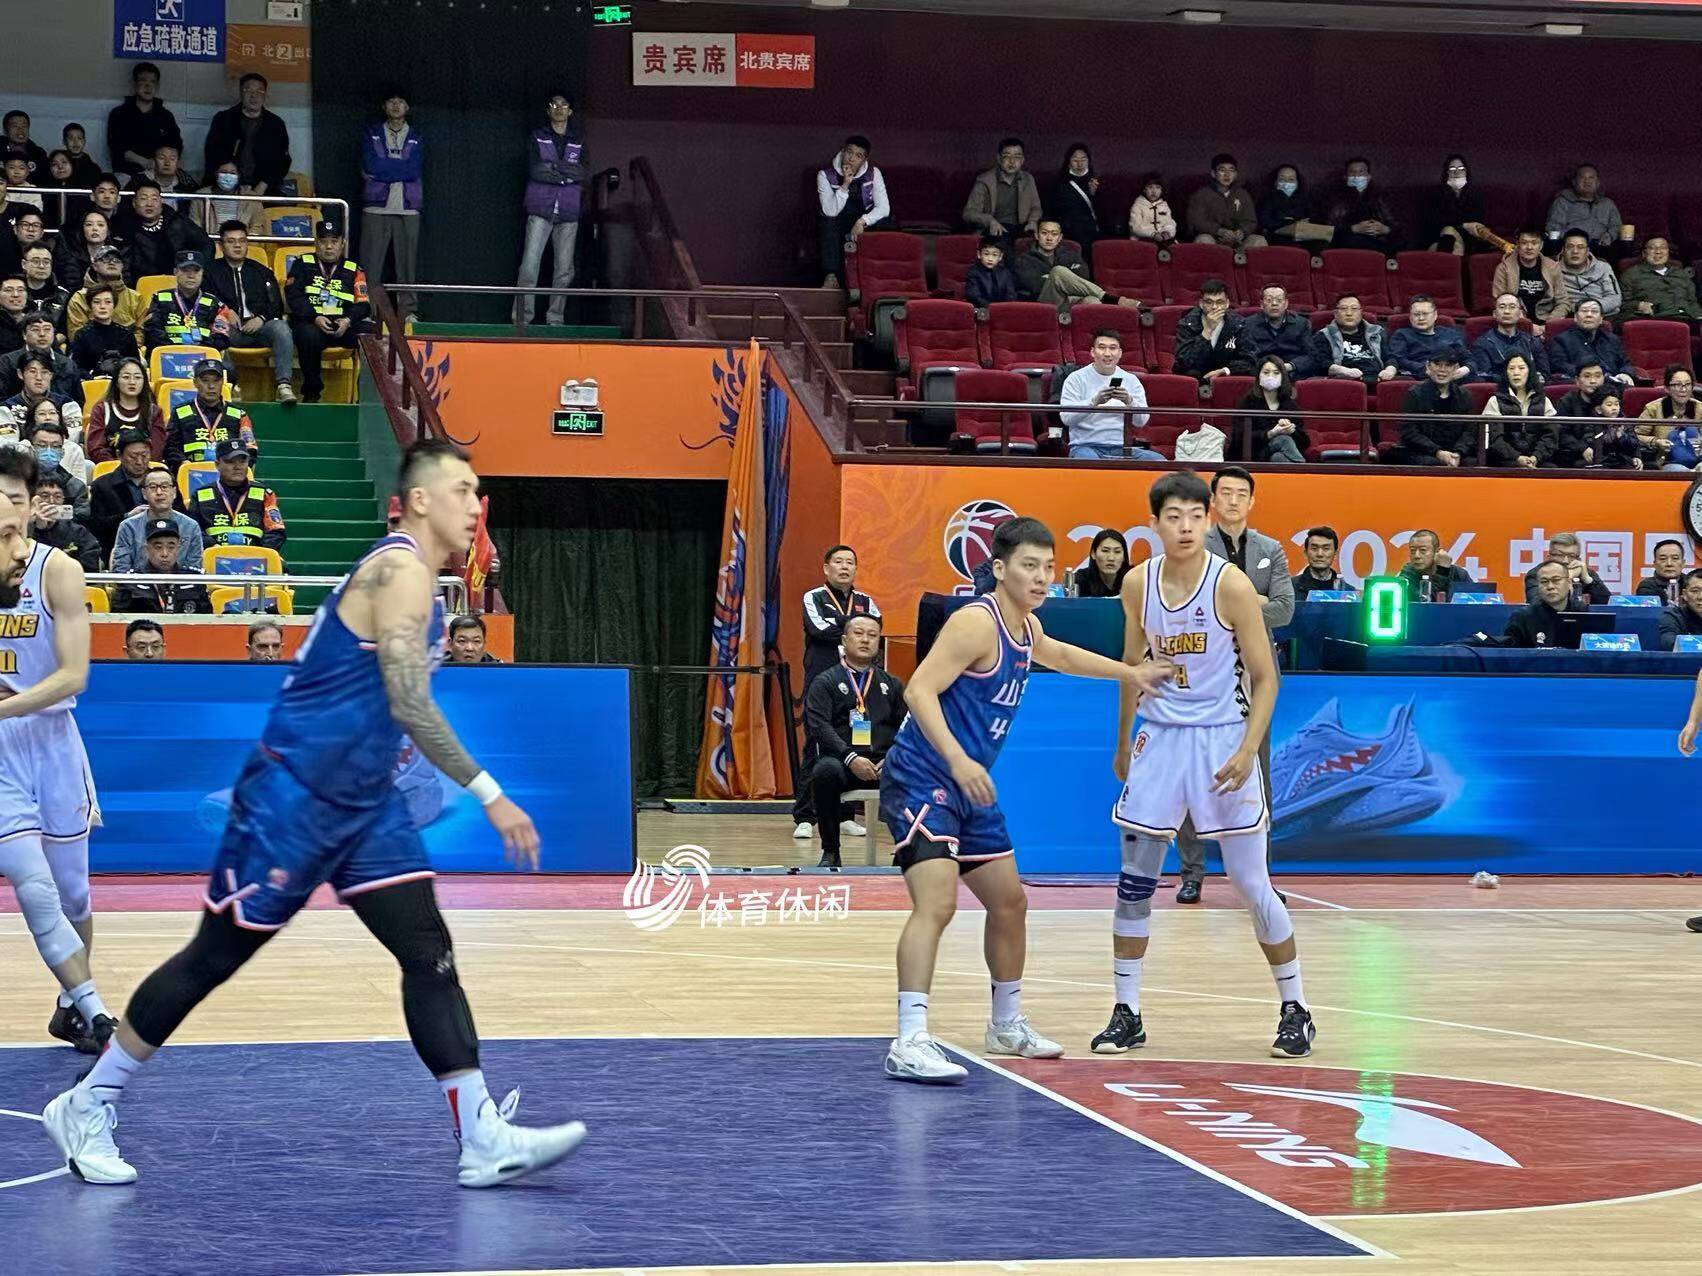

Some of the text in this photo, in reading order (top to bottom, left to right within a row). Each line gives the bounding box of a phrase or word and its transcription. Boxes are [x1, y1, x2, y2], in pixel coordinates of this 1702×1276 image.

[122, 22, 218, 56] 应急疏散通道
[642, 44, 727, 75] 贵宾席
[740, 51, 812, 71] 北贵宾席
[195, 427, 229, 441] 安保
[213, 512, 250, 527] 安保
[1370, 581, 1402, 638] 0
